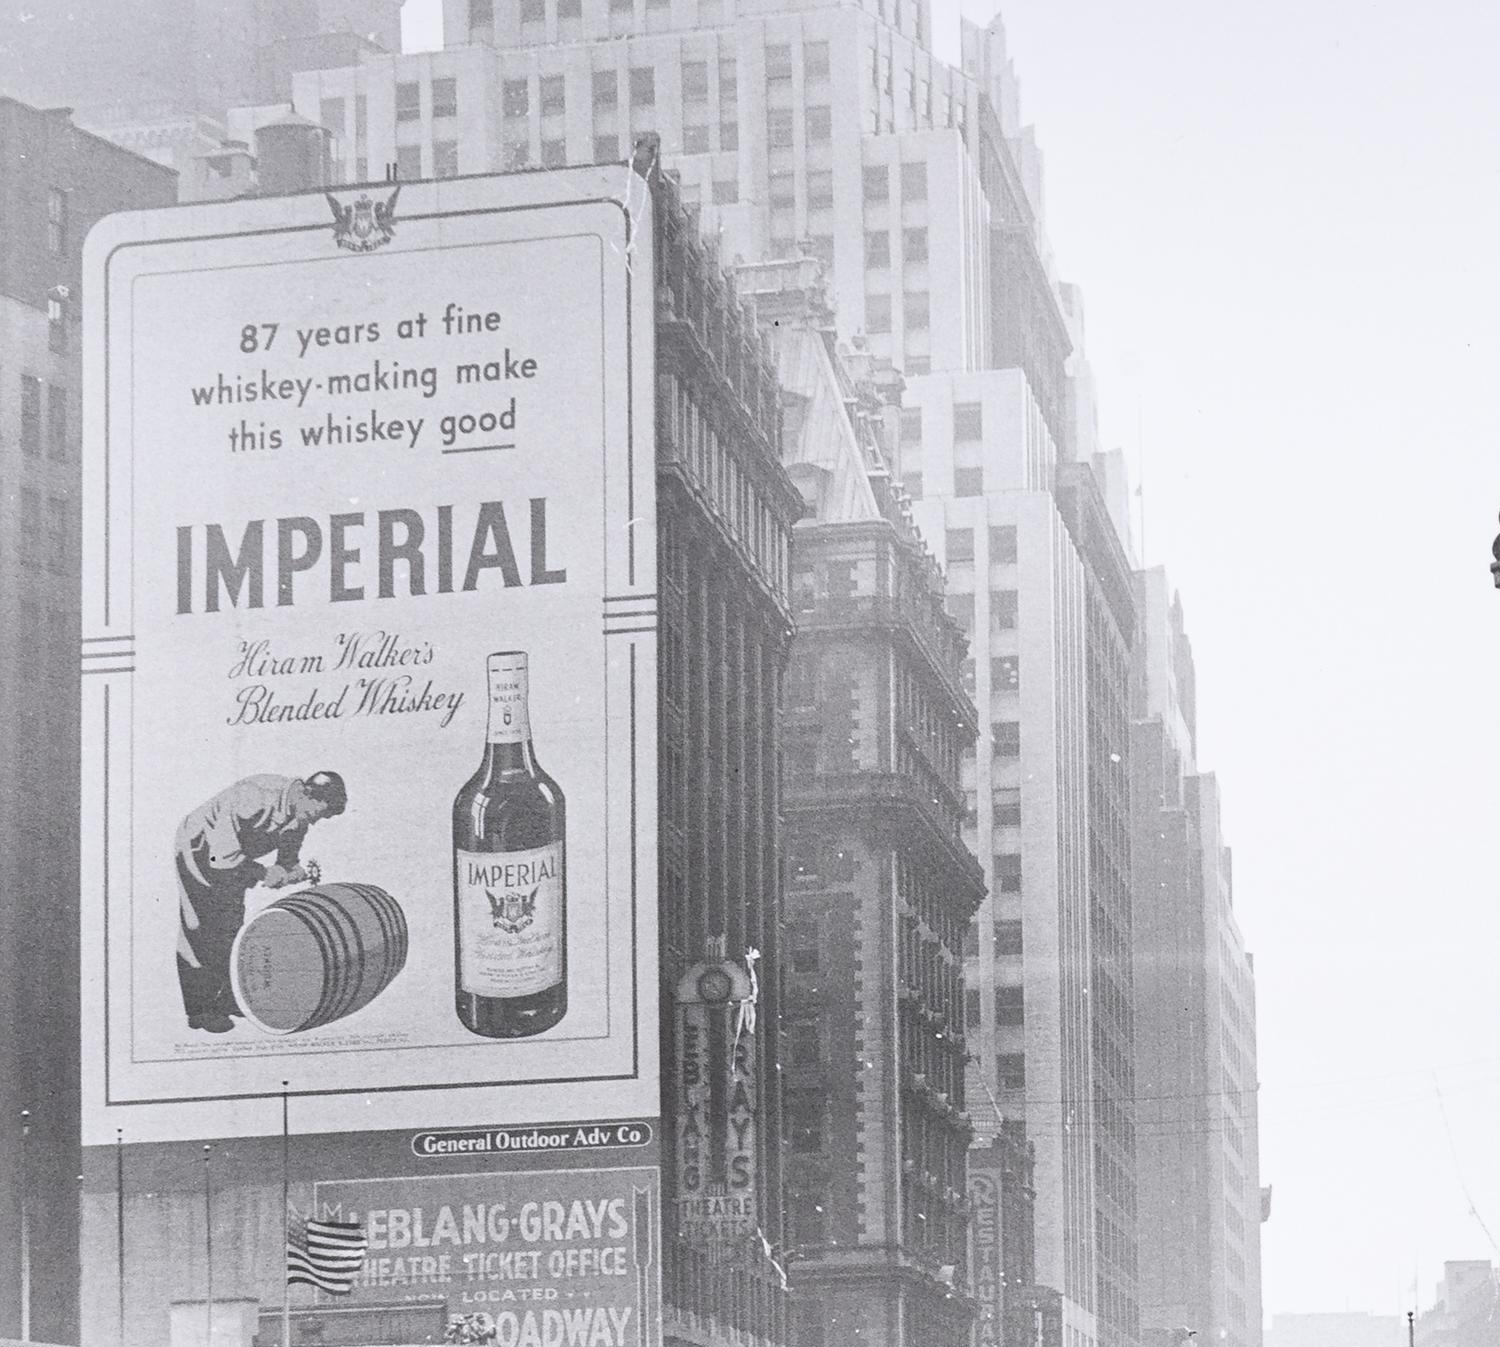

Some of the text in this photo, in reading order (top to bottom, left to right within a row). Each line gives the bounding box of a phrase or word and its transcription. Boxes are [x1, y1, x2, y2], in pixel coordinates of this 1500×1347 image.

[239, 303, 501, 358] 87 years at fine
[191, 348, 538, 408] whiskey-making make
[229, 396, 516, 452] this whiskey good
[175, 497, 567, 615] IMPERIAL
[228, 630, 434, 679] Hiram Walker's
[227, 675, 465, 727] Blended Whiskey
[468, 856, 557, 888] IMPERIAL
[423, 1126, 642, 1154] General Outdoor Adv Co
[357, 1247, 627, 1287] HEATRE TICKET OFFICE
[462, 1287, 558, 1302] LOCATED
